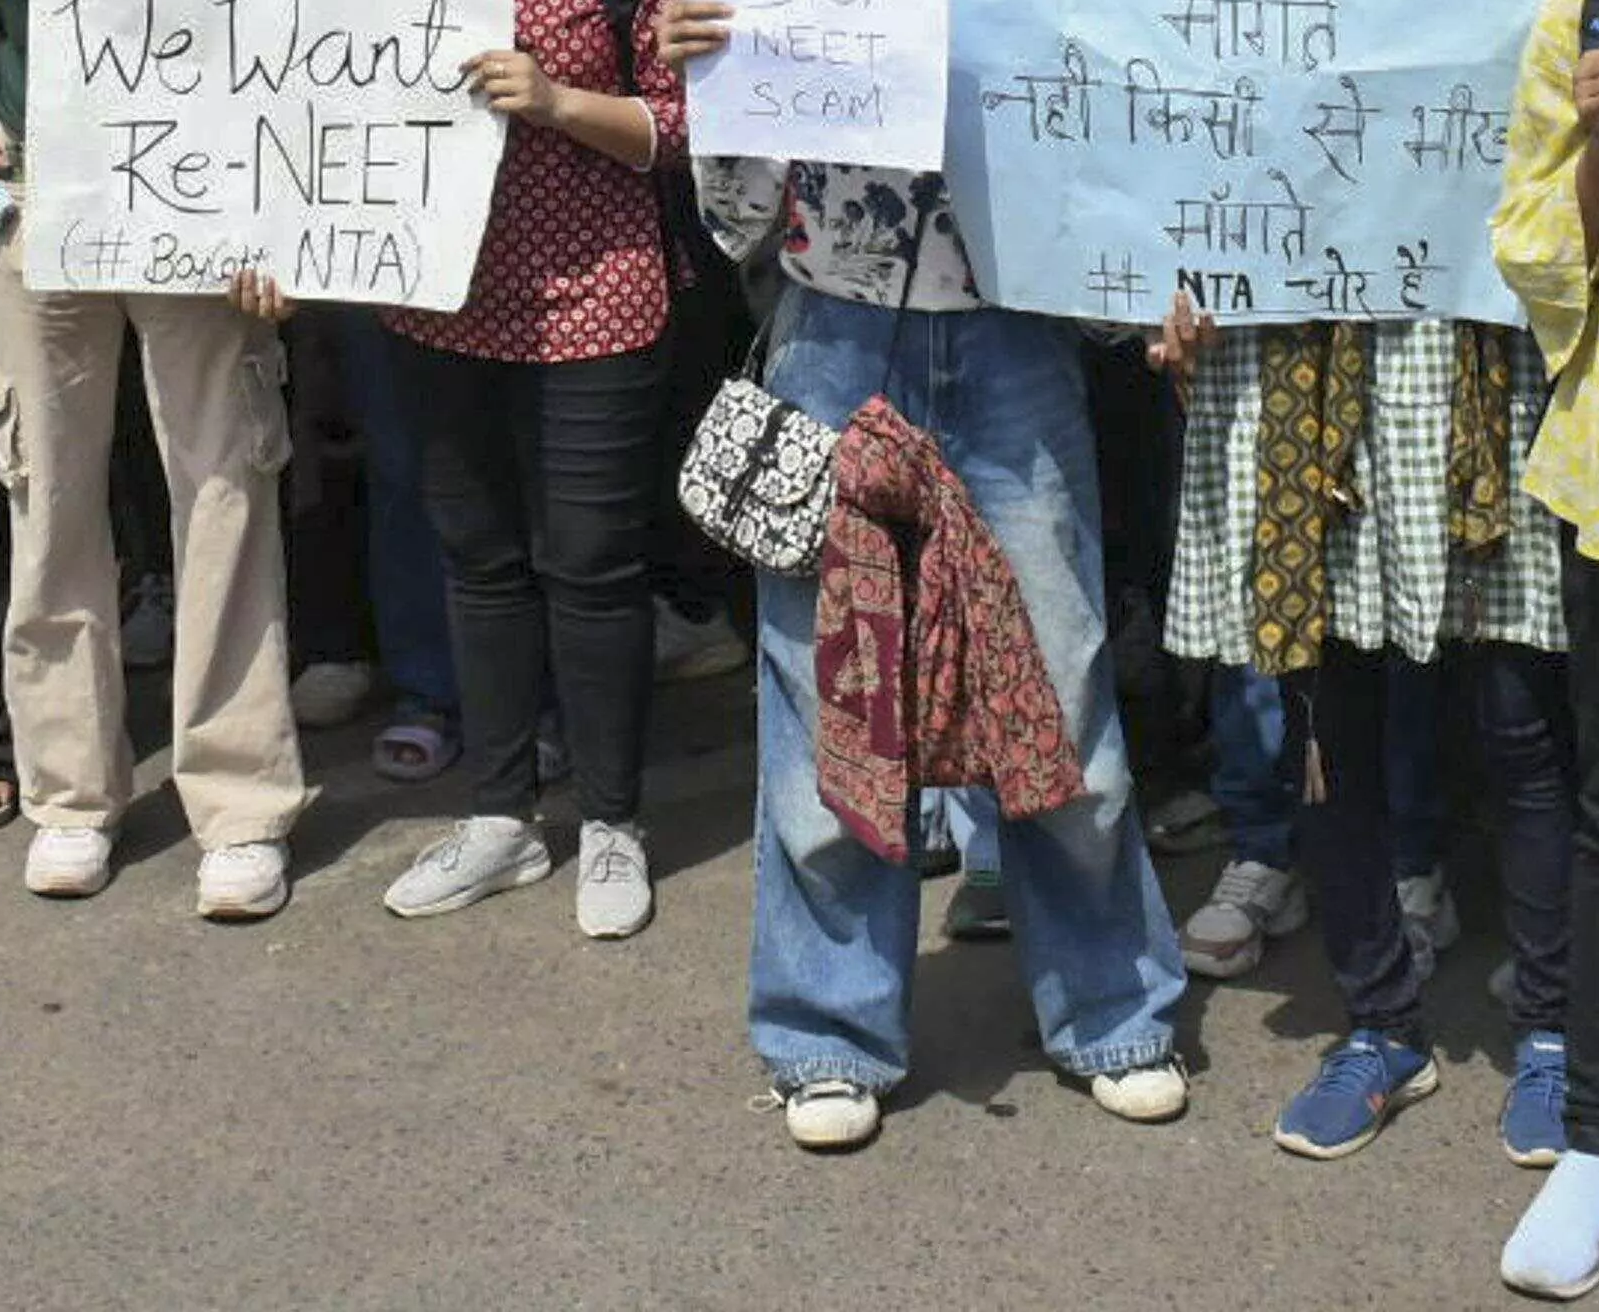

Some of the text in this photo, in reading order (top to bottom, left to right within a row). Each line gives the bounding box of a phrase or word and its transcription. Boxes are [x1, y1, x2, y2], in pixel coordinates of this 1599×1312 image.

[752, 24, 887, 82] NEET
[746, 82, 884, 128] SCAM
[1122, 58, 1266, 161] किसी
[1302, 74, 1382, 184] से
[100, 99, 454, 214] Re-NEET
[1176, 266, 1254, 310] NTA
